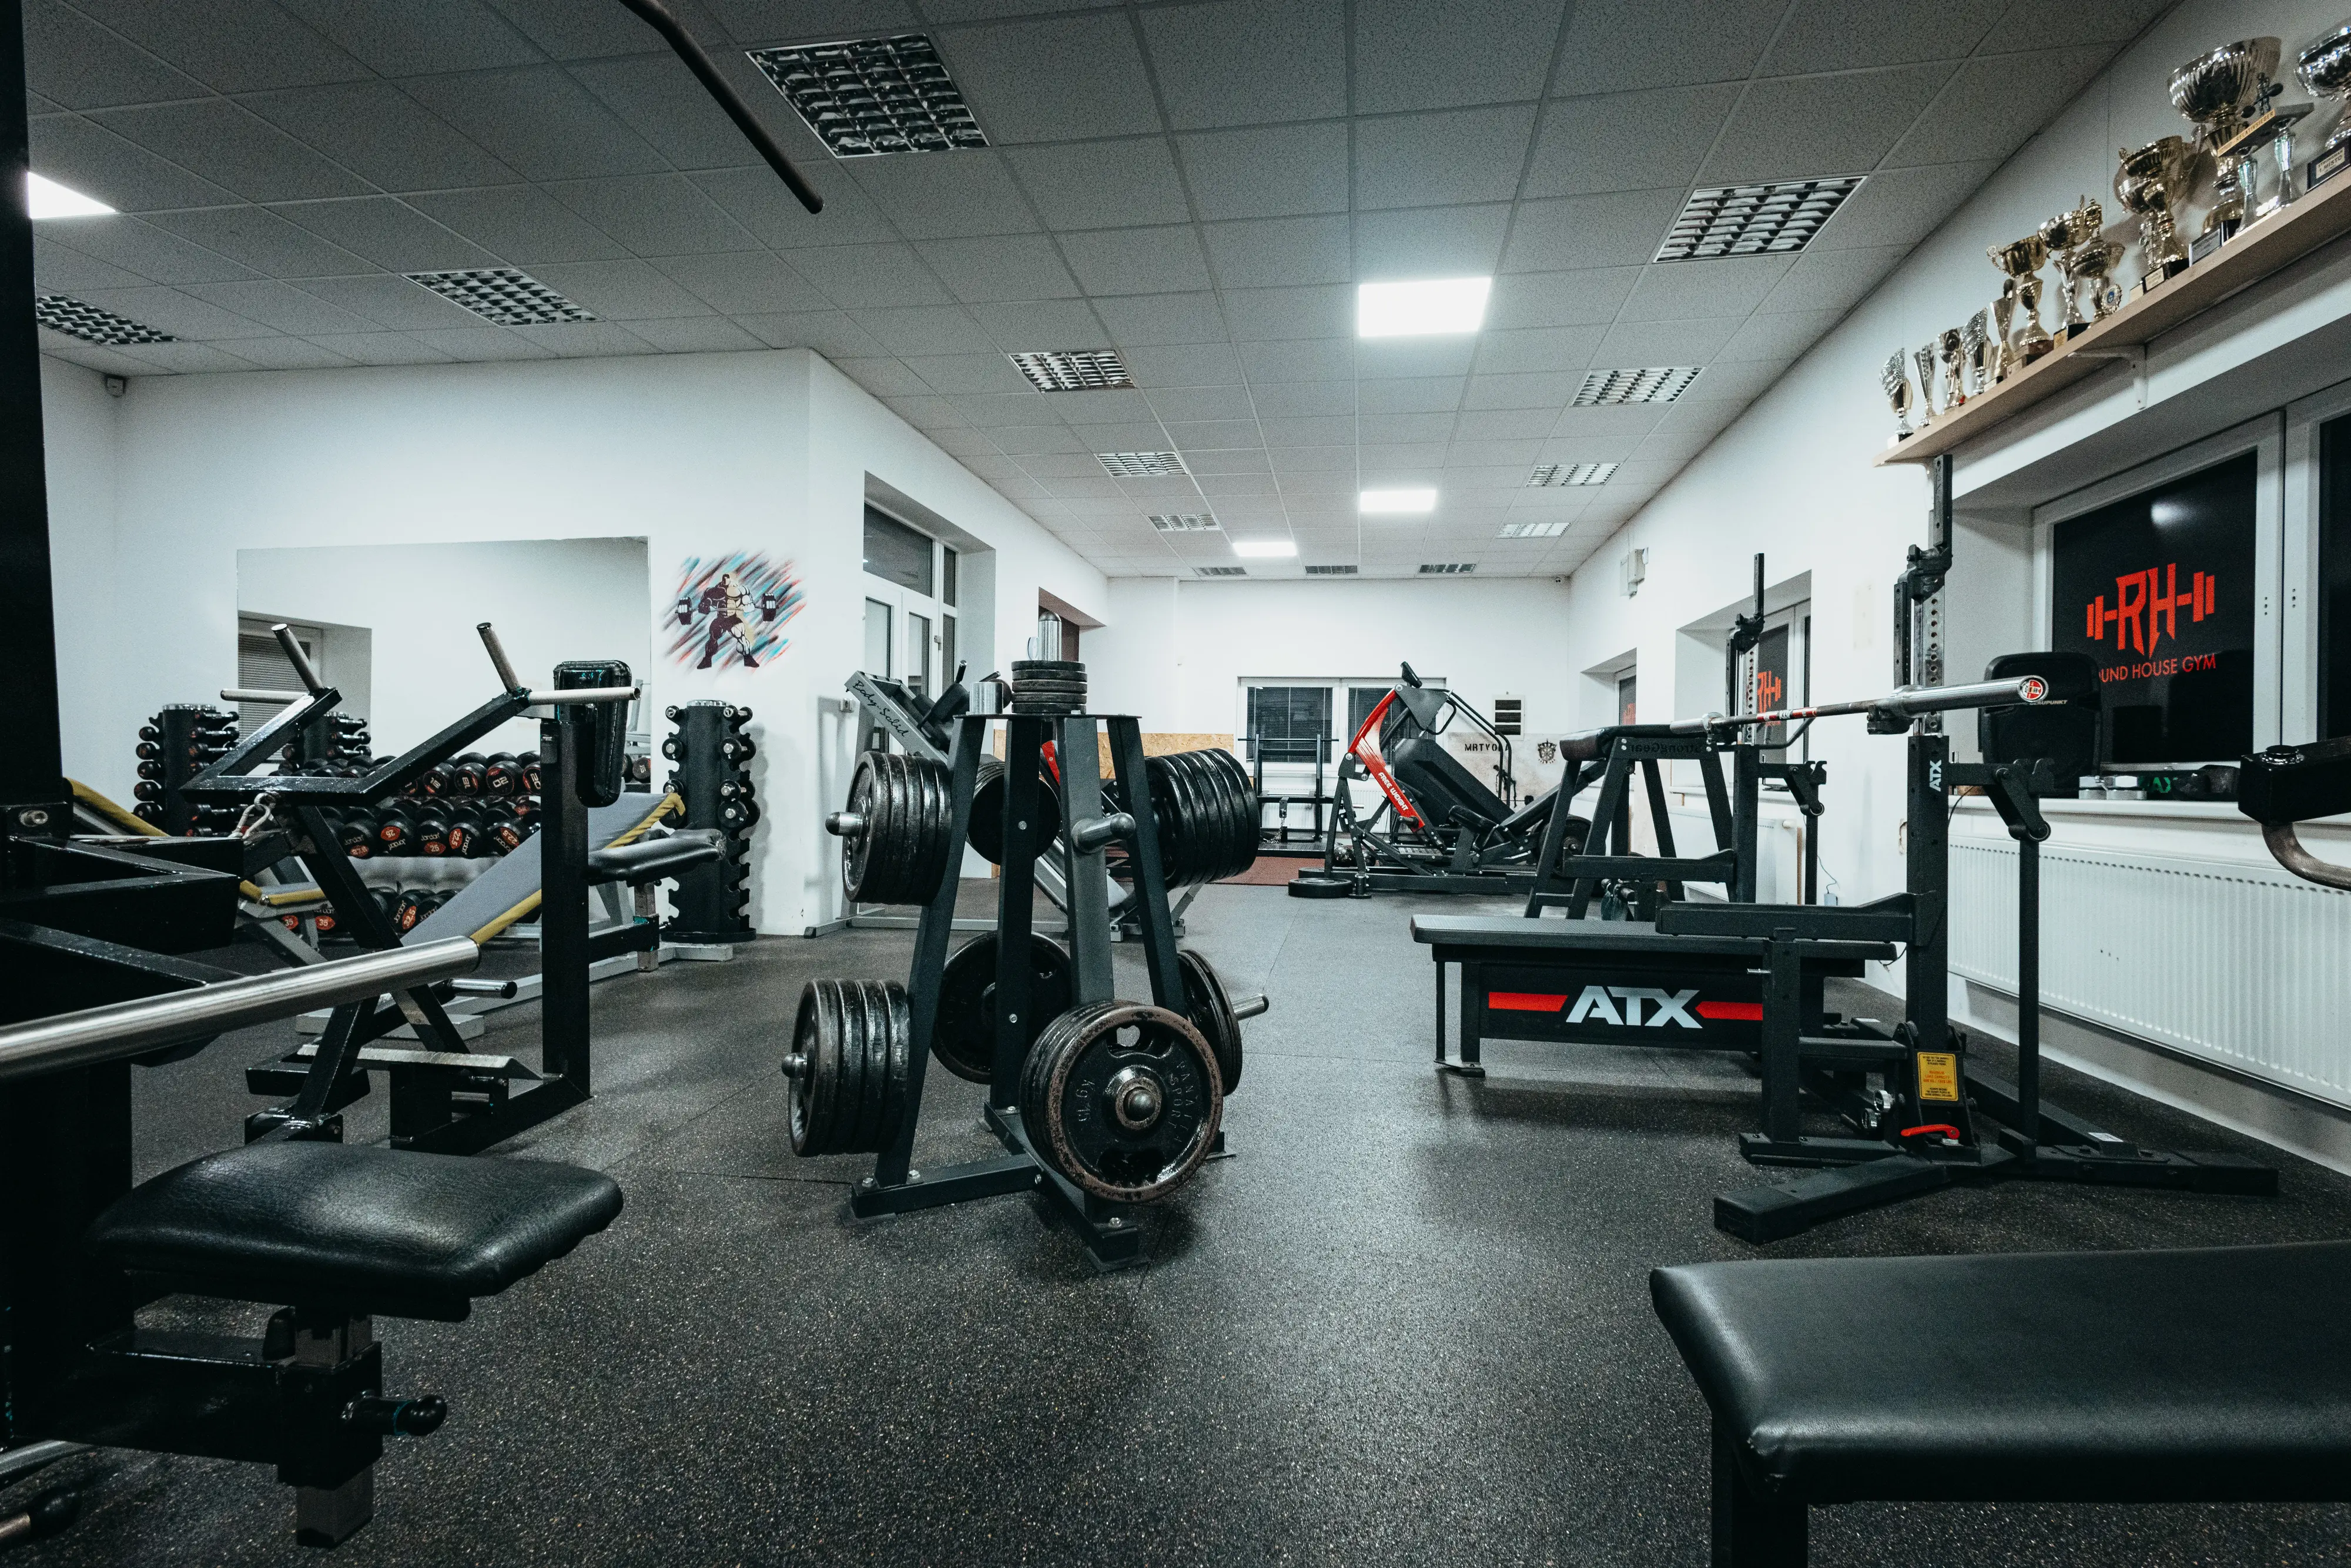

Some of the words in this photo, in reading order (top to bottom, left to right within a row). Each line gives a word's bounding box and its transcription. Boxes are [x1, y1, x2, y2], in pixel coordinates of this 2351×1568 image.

[2099, 666, 2128, 683] UND
[2132, 658, 2178, 679] HOUSE
[2182, 653, 2216, 672] GYM
[852, 680, 909, 737] Body-Solid
[493, 776, 508, 788] 20
[530, 773, 541, 789] 20
[1929, 760, 1942, 792] ATX
[1378, 772, 1392, 789] FREE
[1389, 788, 1409, 811] WEIGHT
[421, 833, 440, 841] Jordan
[430, 844, 440, 852] 25
[452, 830, 460, 846] 22.5
[461, 834, 472, 855] Jordan
[394, 900, 407, 923] Jordan
[1565, 985, 1703, 1029] ATX
